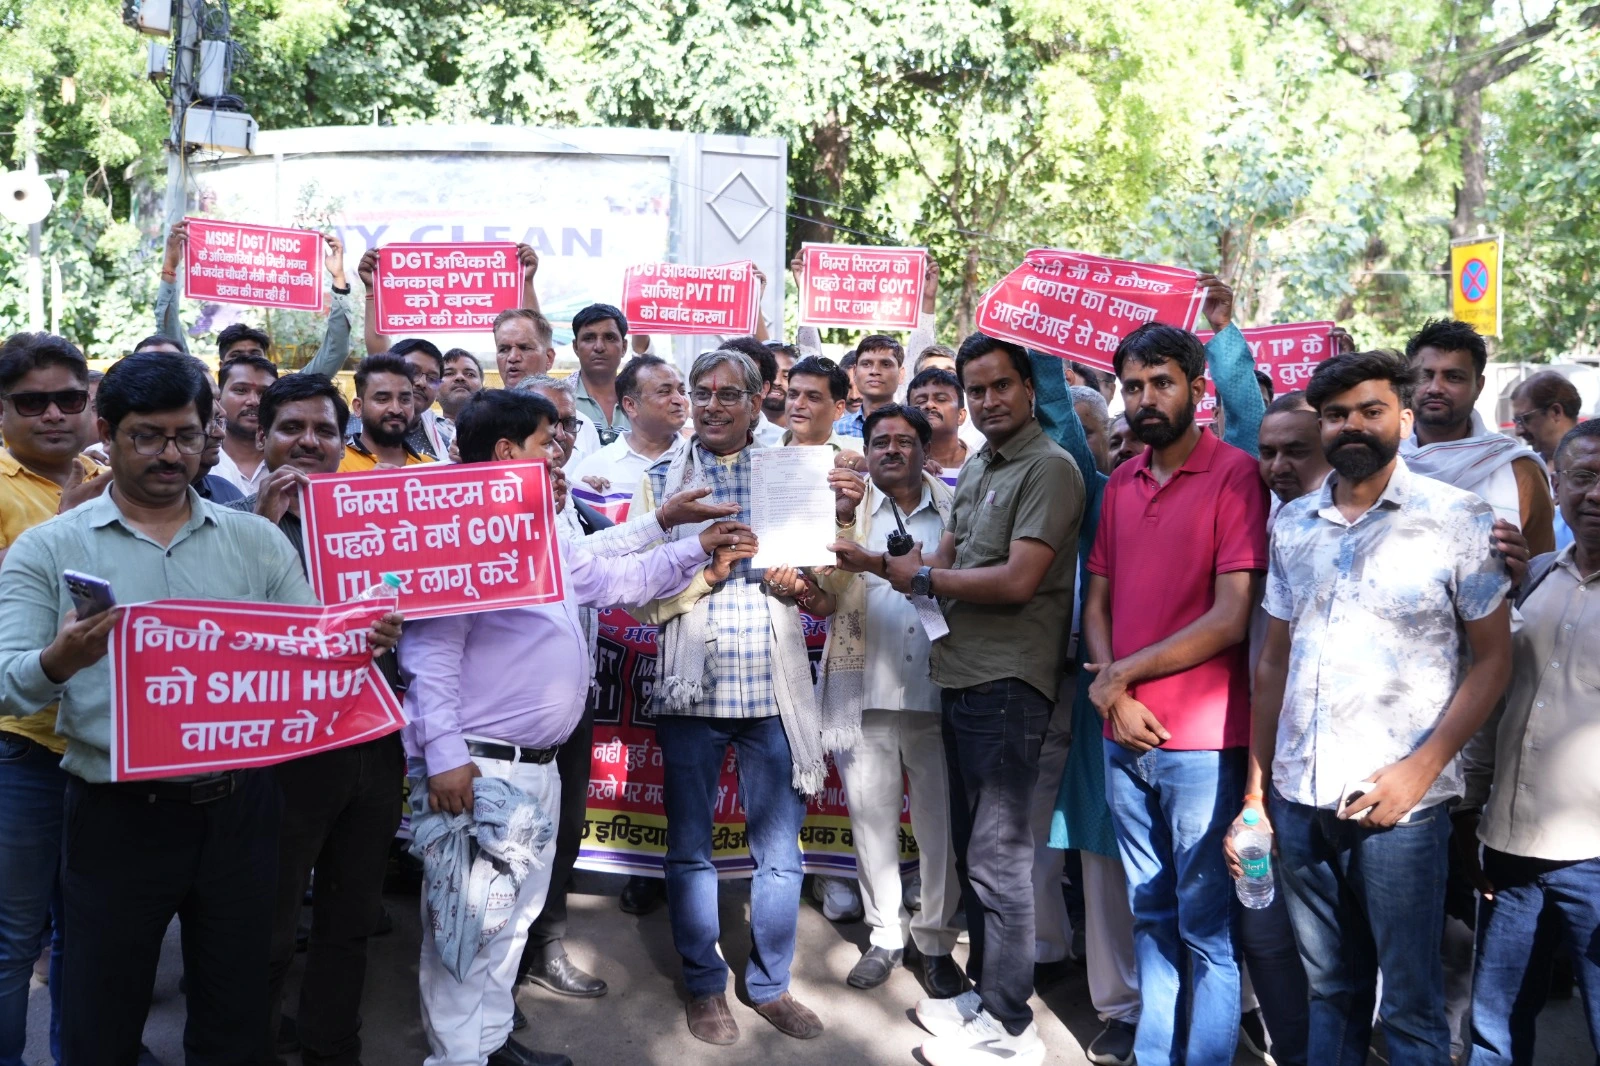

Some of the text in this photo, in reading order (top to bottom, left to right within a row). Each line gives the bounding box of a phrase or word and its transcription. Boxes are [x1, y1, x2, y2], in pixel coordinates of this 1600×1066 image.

[391, 251, 506, 269] DGT अधिकारी
[819, 252, 910, 274] निम्स सिस्टम को
[382, 272, 515, 289] बेनकाब PVT ITI
[641, 279, 735, 302] साजिश PVT ITI
[812, 273, 914, 294] पहले दो वर्ष GOVT.
[1066, 264, 1090, 280] जी
[1092, 266, 1112, 283] के
[1115, 271, 1173, 293] कौशल
[404, 289, 495, 308] को बन्द
[815, 296, 830, 312] ITI
[834, 299, 851, 313] पर
[852, 300, 879, 320] लागू
[1021, 275, 1158, 325] विकास का सपना
[388, 310, 427, 326] करने
[430, 309, 452, 326] की
[640, 301, 658, 320] को
[659, 302, 691, 321] बर्बाद
[692, 309, 726, 324] करना
[990, 300, 1076, 344] आईटीआई
[1075, 319, 1093, 346] से
[1269, 339, 1294, 356] TP
[1301, 334, 1324, 354] के
[333, 471, 523, 517] निम्स सिस्टम को
[324, 512, 539, 559] पहले दो वर्ष GOVT.
[418, 563, 480, 599] लागू
[478, 549, 518, 585] करें
[132, 616, 225, 652] निजी
[145, 666, 197, 706] को
[180, 719, 275, 752] वापस
[282, 710, 318, 744] दो
